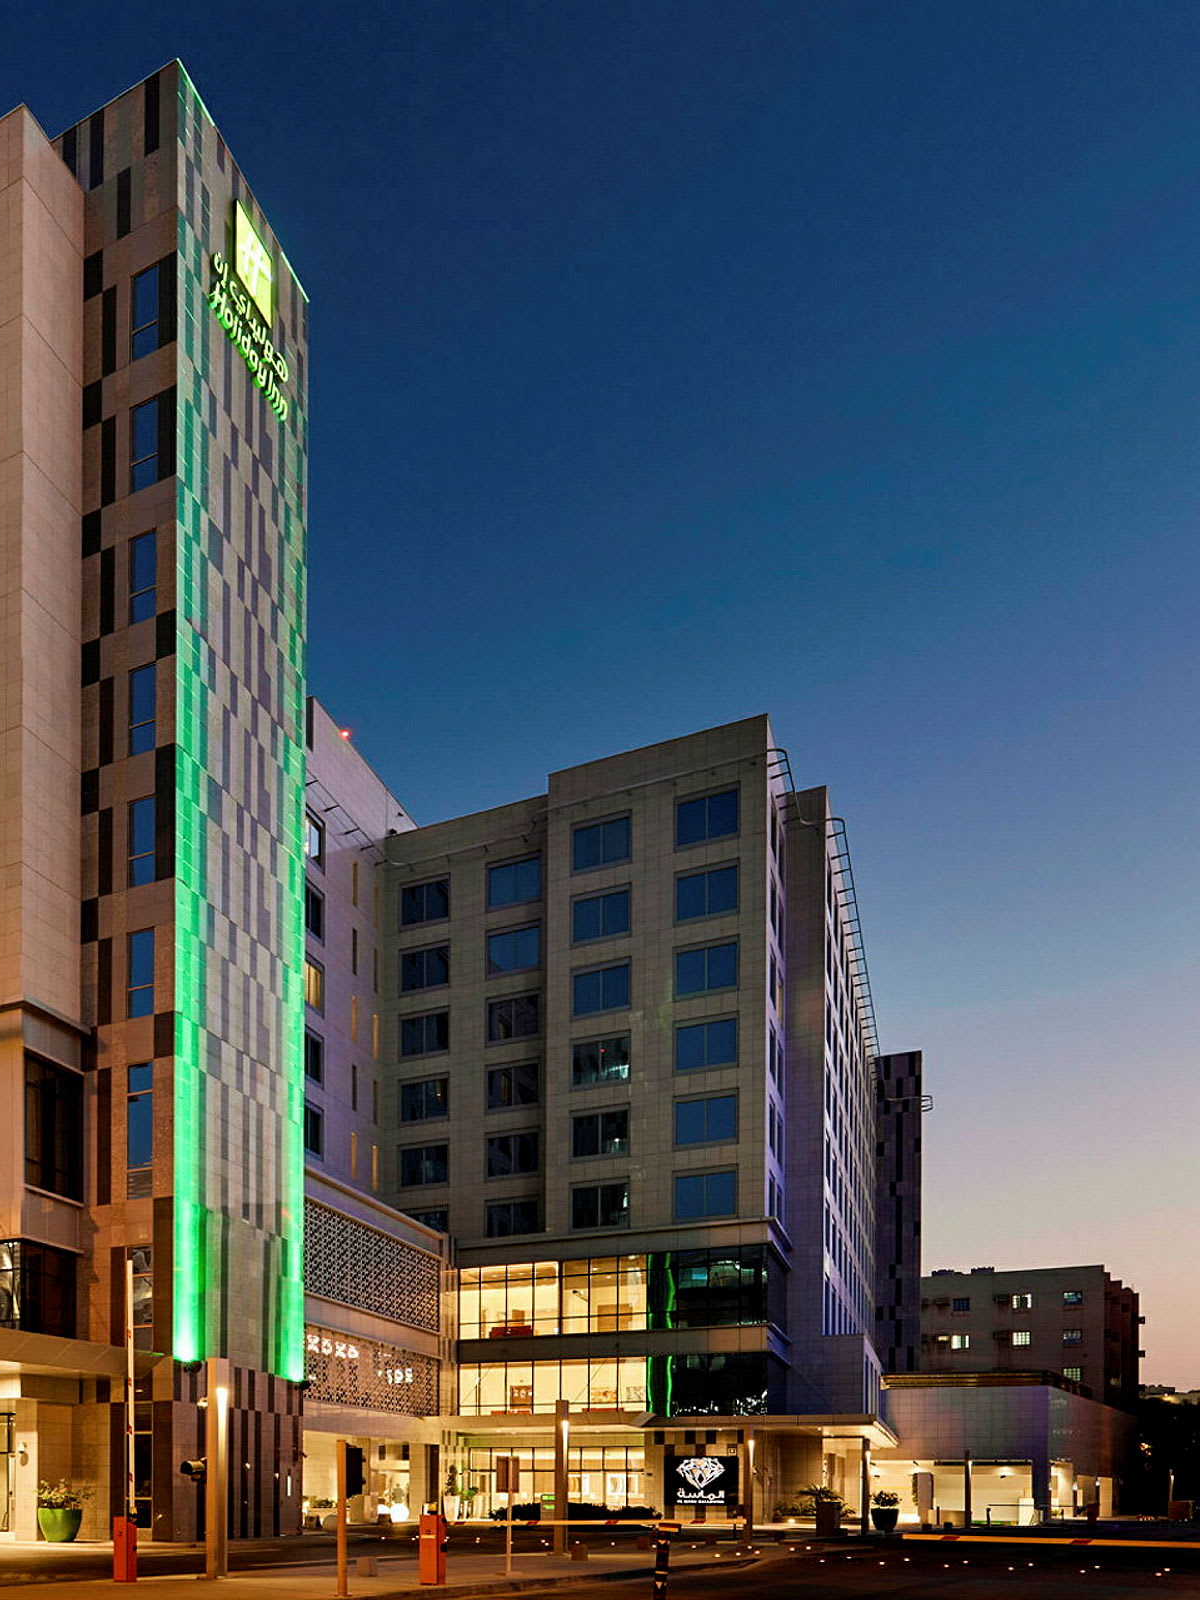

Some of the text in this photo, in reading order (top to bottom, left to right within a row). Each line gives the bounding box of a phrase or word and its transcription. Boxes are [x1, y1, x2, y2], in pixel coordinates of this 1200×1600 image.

[209, 281, 288, 422] Holiday Inn
[677, 1487, 725, 1500] الماسة
